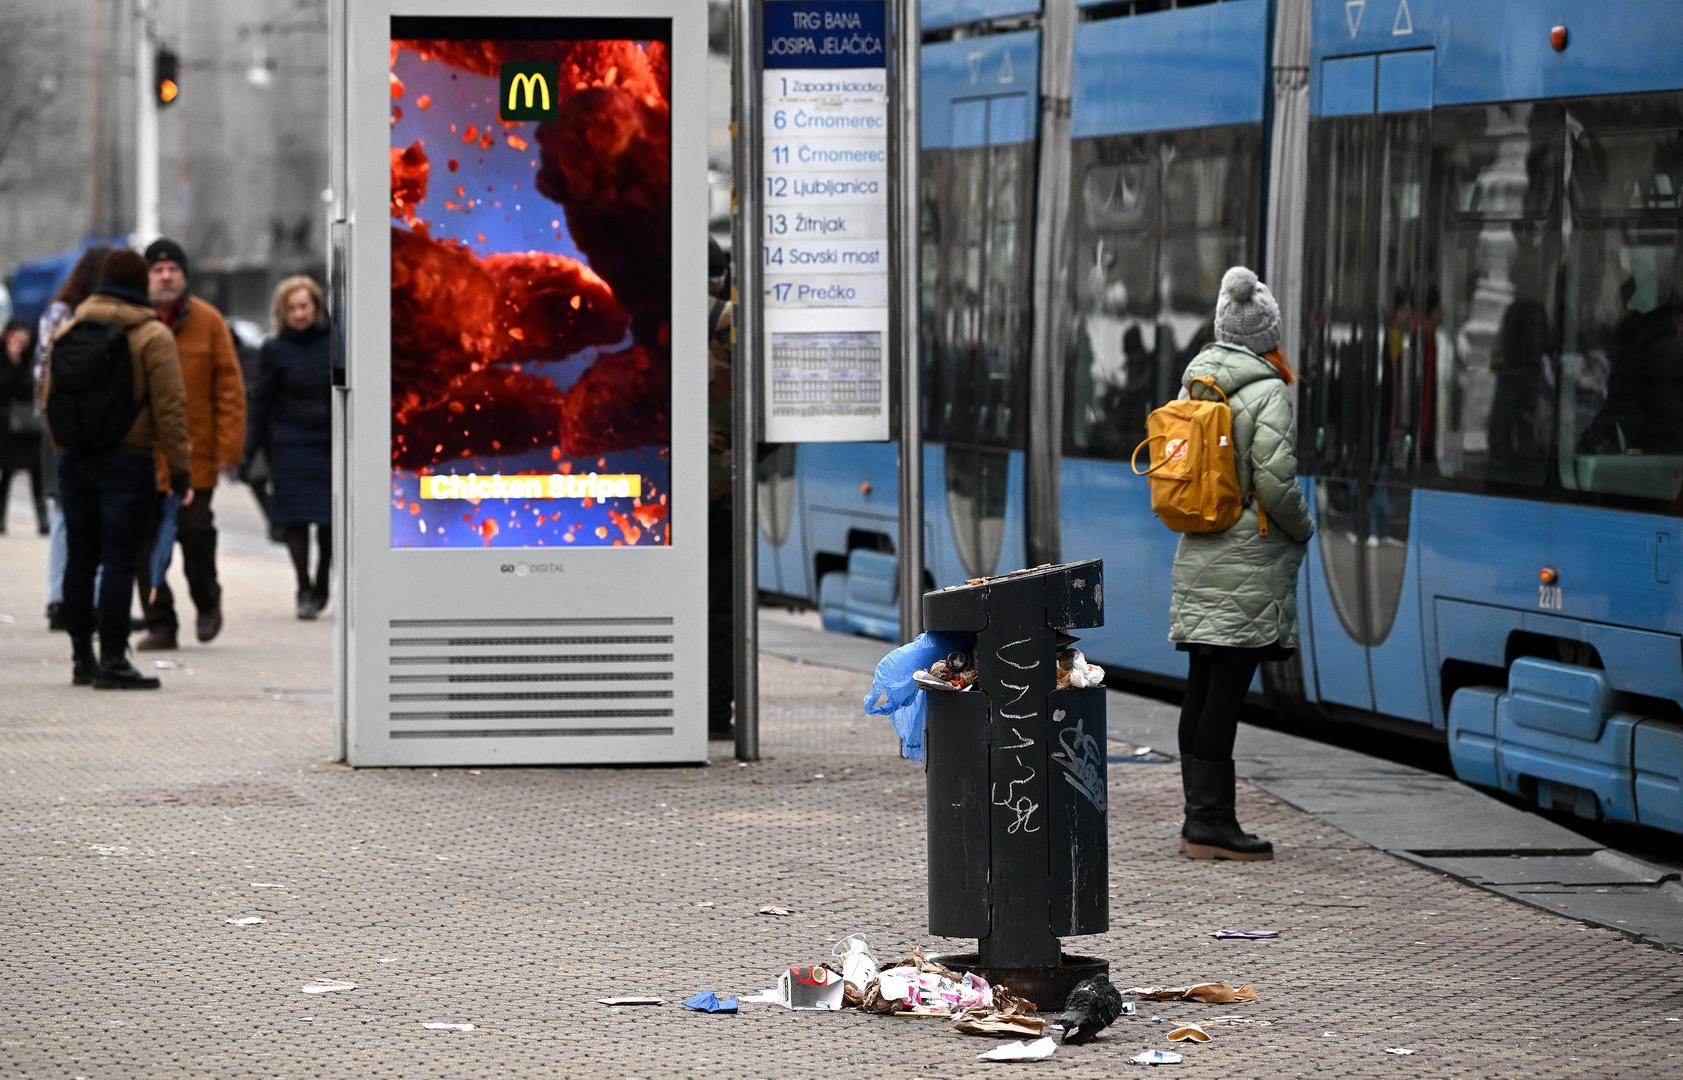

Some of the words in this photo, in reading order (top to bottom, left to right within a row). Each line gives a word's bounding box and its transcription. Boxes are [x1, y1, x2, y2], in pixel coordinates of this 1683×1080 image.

[792, 12, 821, 30] TRG
[824, 12, 861, 30] BANA
[768, 37, 816, 55] JOSIPA
[819, 33, 882, 55] JELAČIĆA
[780, 77, 787, 97] 1
[792, 80, 839, 94] Zapadni
[774, 110, 787, 130] 6
[793, 109, 884, 129] Črnomerec
[772, 145, 790, 165] 11
[798, 144, 886, 163] Črnomerec
[766, 177, 787, 198] 12
[793, 179, 879, 198] Ljubljanica
[767, 214, 788, 235] 13
[795, 212, 846, 235] Žitnjak
[763, 246, 783, 267] 14
[789, 248, 838, 265] Savski
[842, 249, 880, 265] most
[772, 282, 792, 302] 17
[798, 284, 856, 301] Prečko
[430, 473, 542, 499] Chicken
[547, 472, 631, 504] Strips
